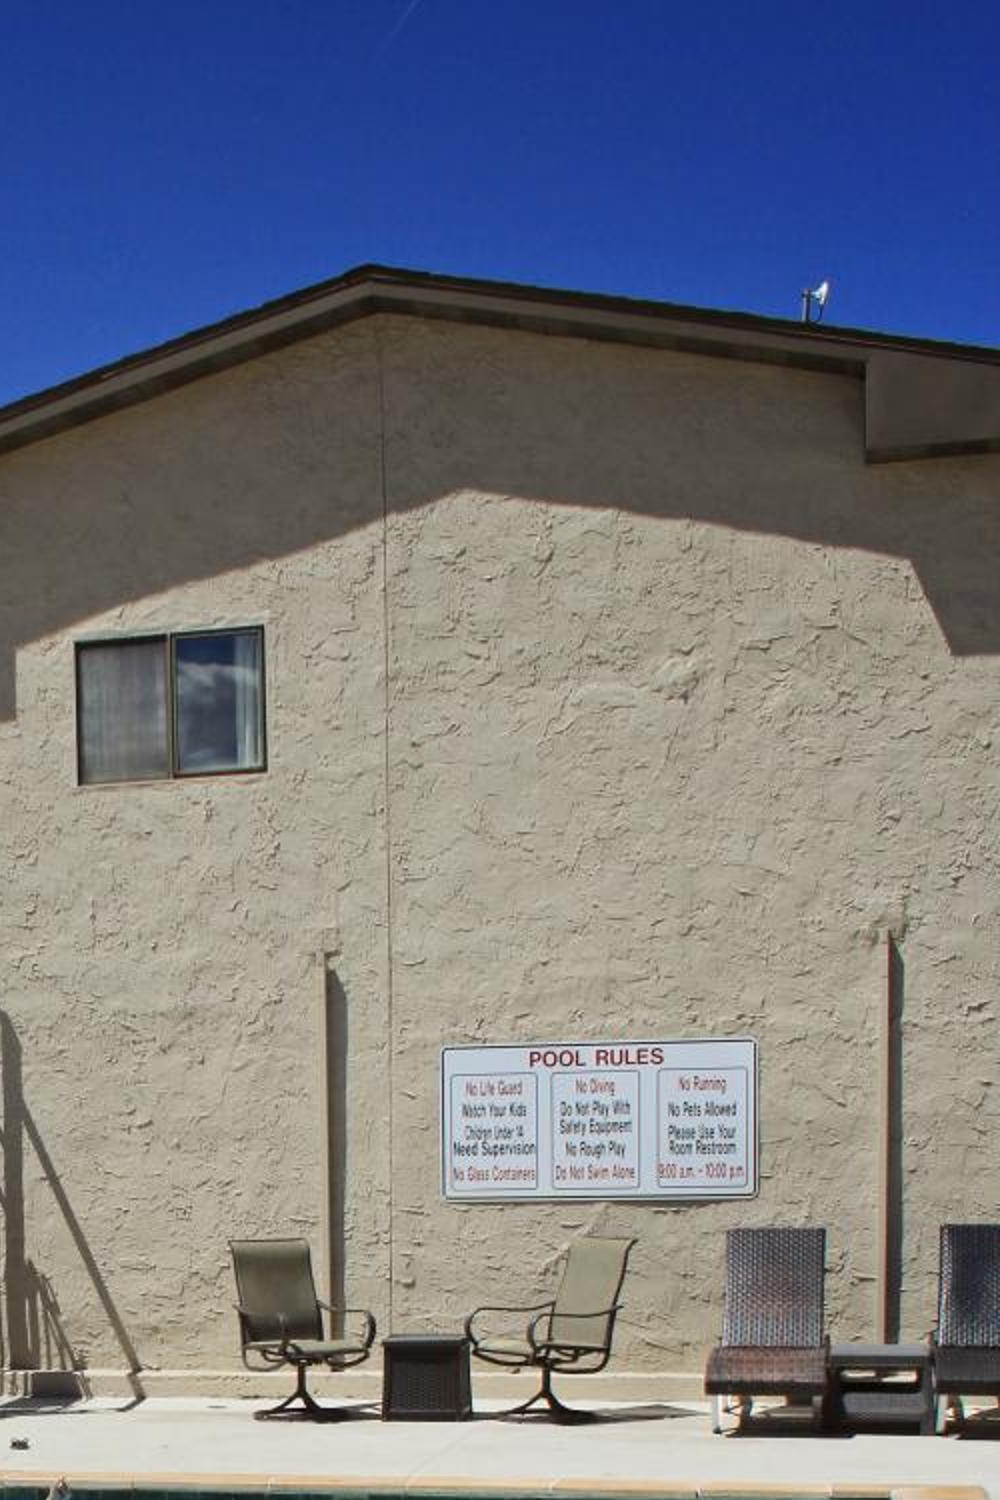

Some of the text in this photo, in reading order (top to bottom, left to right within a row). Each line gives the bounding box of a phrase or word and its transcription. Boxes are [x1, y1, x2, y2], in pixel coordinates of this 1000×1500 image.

[529, 1047, 665, 1067] POOL RULES
[465, 1080, 522, 1096] No Life Guard
[575, 1078, 615, 1096] No Diving
[679, 1076, 727, 1094] No Running
[462, 1102, 527, 1118] Watch Your Kids
[560, 1100, 630, 1118] Do Not Play With
[668, 1101, 737, 1117] No Pets Allowed
[464, 1125, 492, 1141] Children
[494, 1125, 513, 1141] Under
[560, 1118, 632, 1136] Safety Equipment
[668, 1124, 736, 1139] Please Use Your
[453, 1141, 536, 1159] Need Supervision
[565, 1140, 625, 1159] No Rough Play
[669, 1140, 737, 1155] Room Restroom
[453, 1165, 536, 1181] No Glass Containers
[556, 1164, 635, 1180] Do Not Swim Alone
